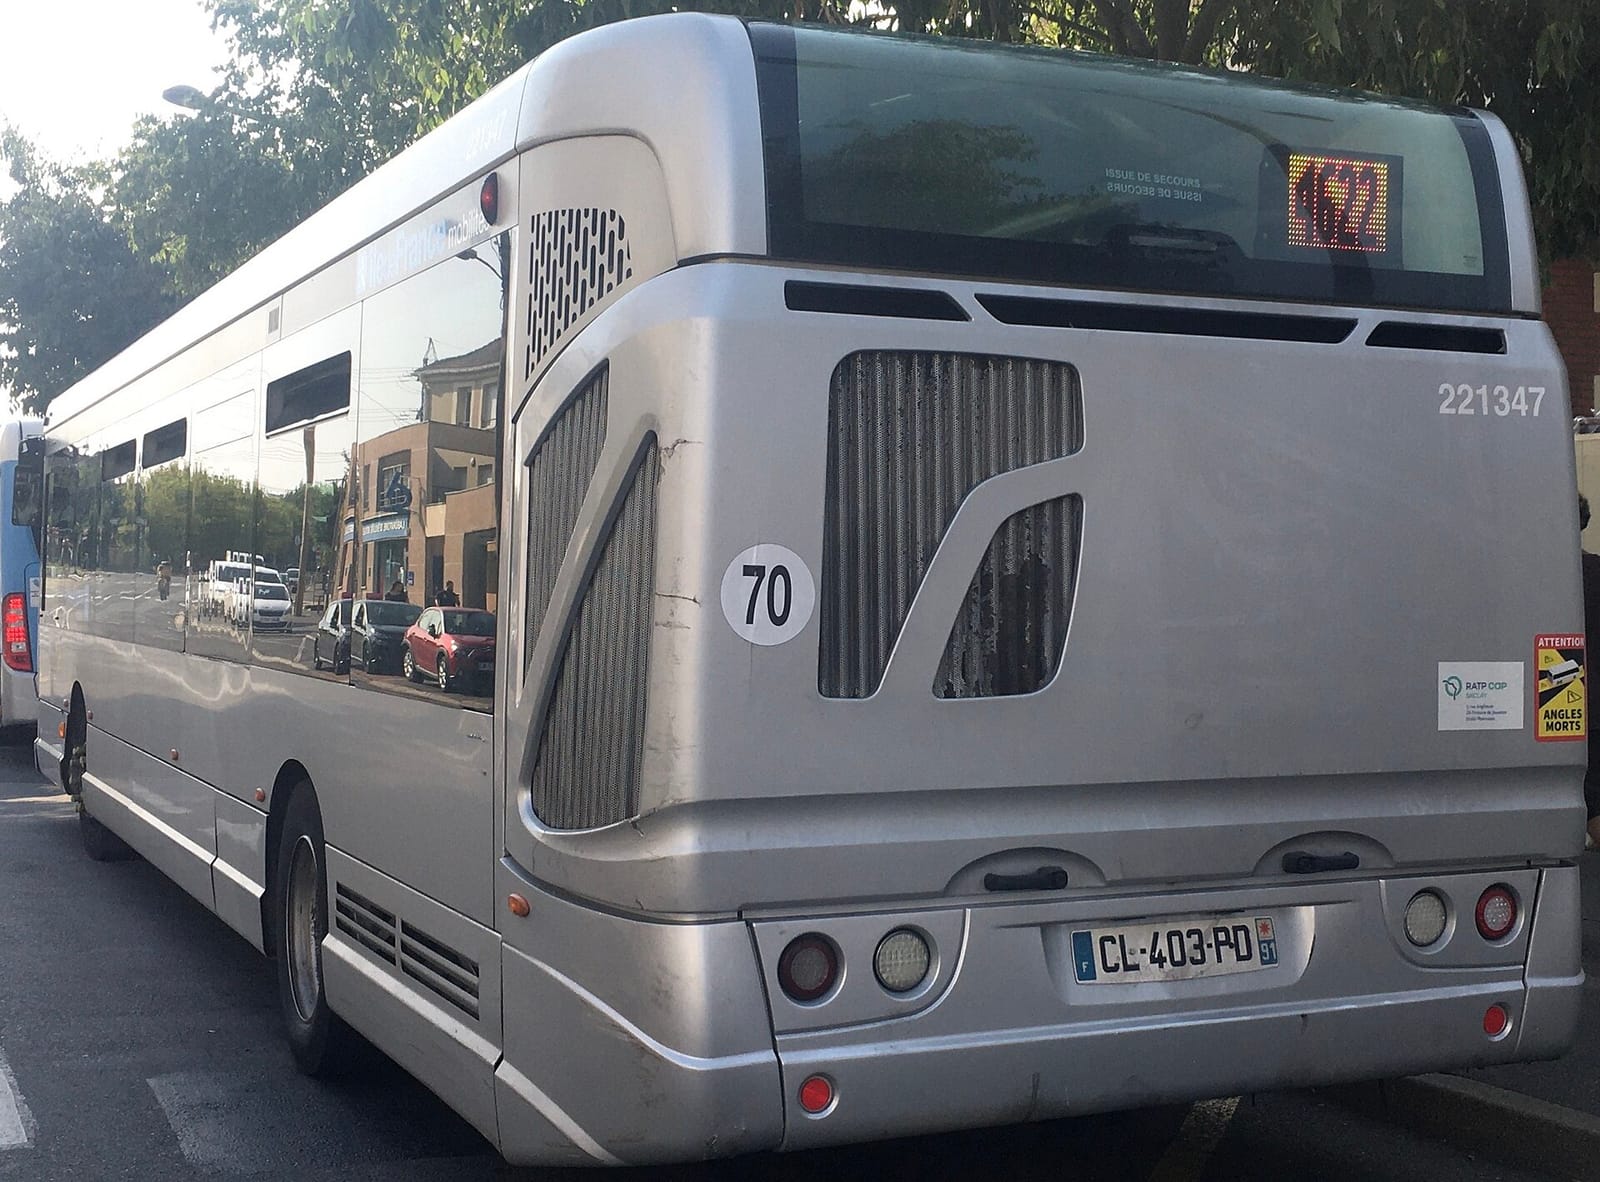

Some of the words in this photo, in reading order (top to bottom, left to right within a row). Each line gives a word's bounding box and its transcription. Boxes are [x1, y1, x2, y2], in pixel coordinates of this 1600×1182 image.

[1105, 168, 1135, 180] ISSUE
[1137, 172, 1151, 182] DE
[1153, 174, 1200, 188] SECOURS
[1438, 383, 1546, 417] 221347
[742, 564, 792, 627] 70
[1466, 682, 1487, 690] RATP
[1543, 709, 1583, 720] ANGLES
[1545, 720, 1581, 732] MORTS
[1099, 924, 1253, 973] CL-403-PD
[1260, 941, 1276, 961] 91
[1081, 961, 1089, 973] F
